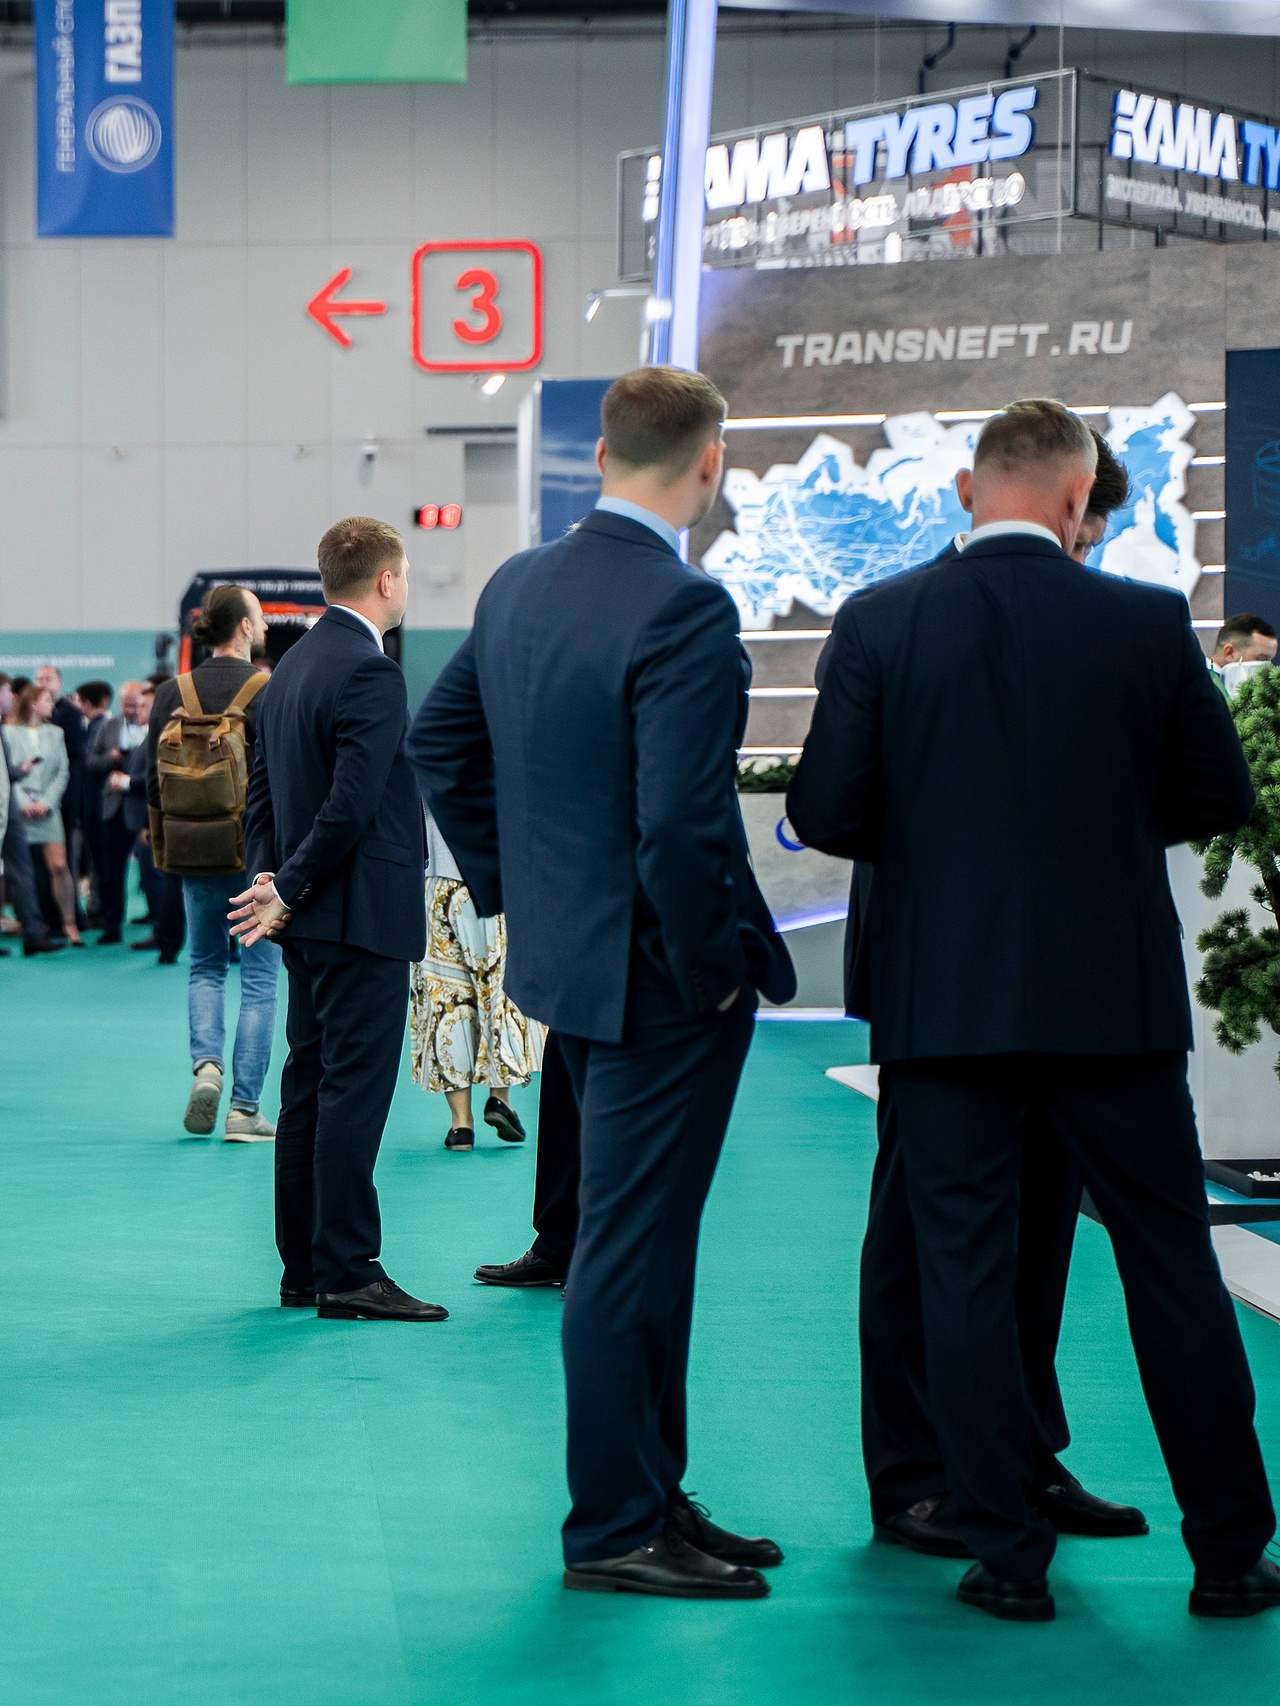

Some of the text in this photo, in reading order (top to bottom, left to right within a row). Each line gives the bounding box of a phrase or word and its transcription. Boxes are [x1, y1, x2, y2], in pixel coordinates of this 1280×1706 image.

[844, 86, 1038, 187] TYRES
[1110, 89, 1239, 182] KAMA
[453, 267, 503, 344] 3
[775, 319, 1133, 368] TRANSNEFT.RU
